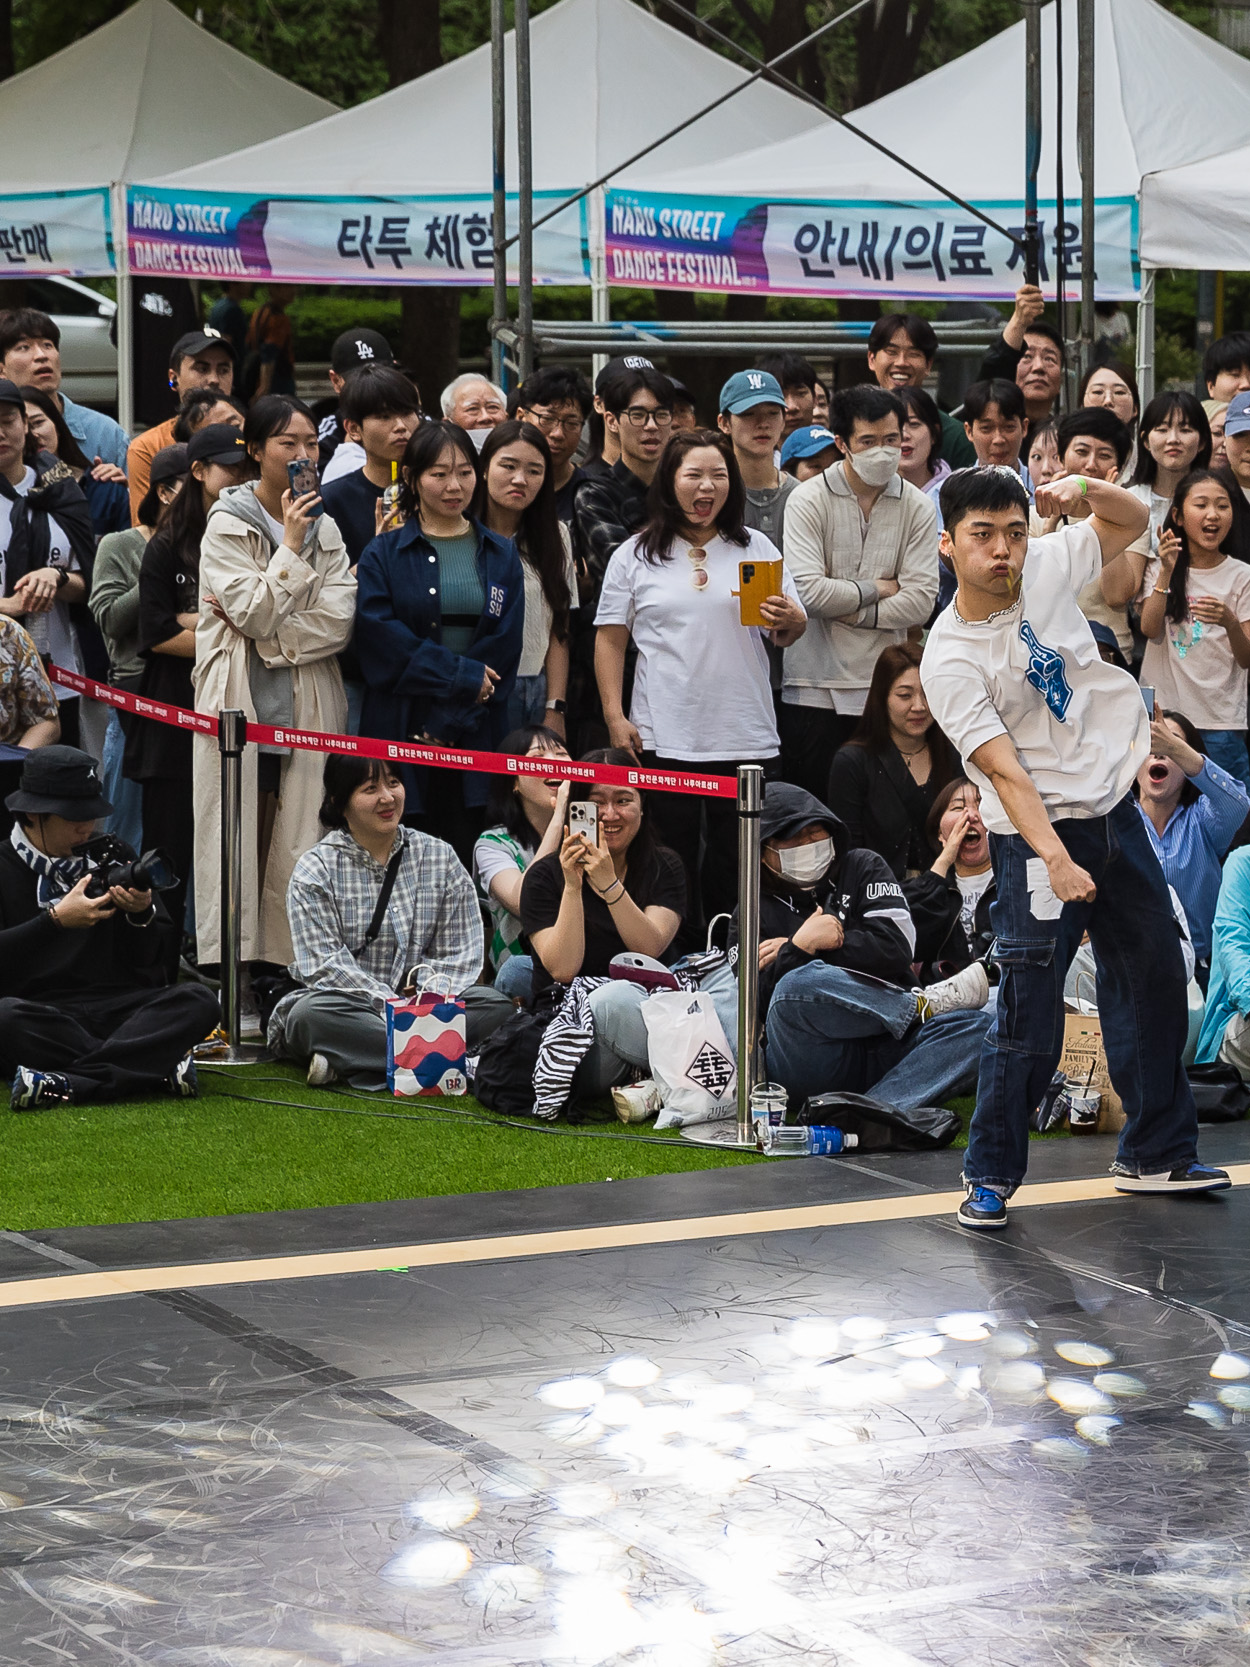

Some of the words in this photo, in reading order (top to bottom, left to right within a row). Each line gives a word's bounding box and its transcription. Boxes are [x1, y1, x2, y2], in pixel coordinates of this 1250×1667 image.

[133, 200, 173, 231] NARU
[174, 203, 231, 234] STREET
[612, 204, 658, 237] NARU
[659, 208, 726, 242] STREET
[337, 215, 412, 269] 타투
[424, 212, 494, 269] 체험
[794, 220, 993, 281] 안내/의료
[134, 241, 180, 271] DANCE
[180, 244, 247, 275] FESTIVAL
[613, 249, 666, 282] DANCE
[666, 252, 742, 287] FESTIVAL
[355, 340, 375, 359] LA
[491, 586, 504, 602] RS
[285, 733, 319, 746] 광진문화재단
[325, 739, 357, 751] 나루아트센터
[399, 748, 434, 761] 광진문화재단
[440, 752, 474, 765] 나루아트센터
[518, 761, 554, 774] 광진문화재단
[560, 766, 595, 777] 나루아트센터
[639, 774, 676, 786] 광진문화재단
[683, 778, 719, 790] 나루아트센터
